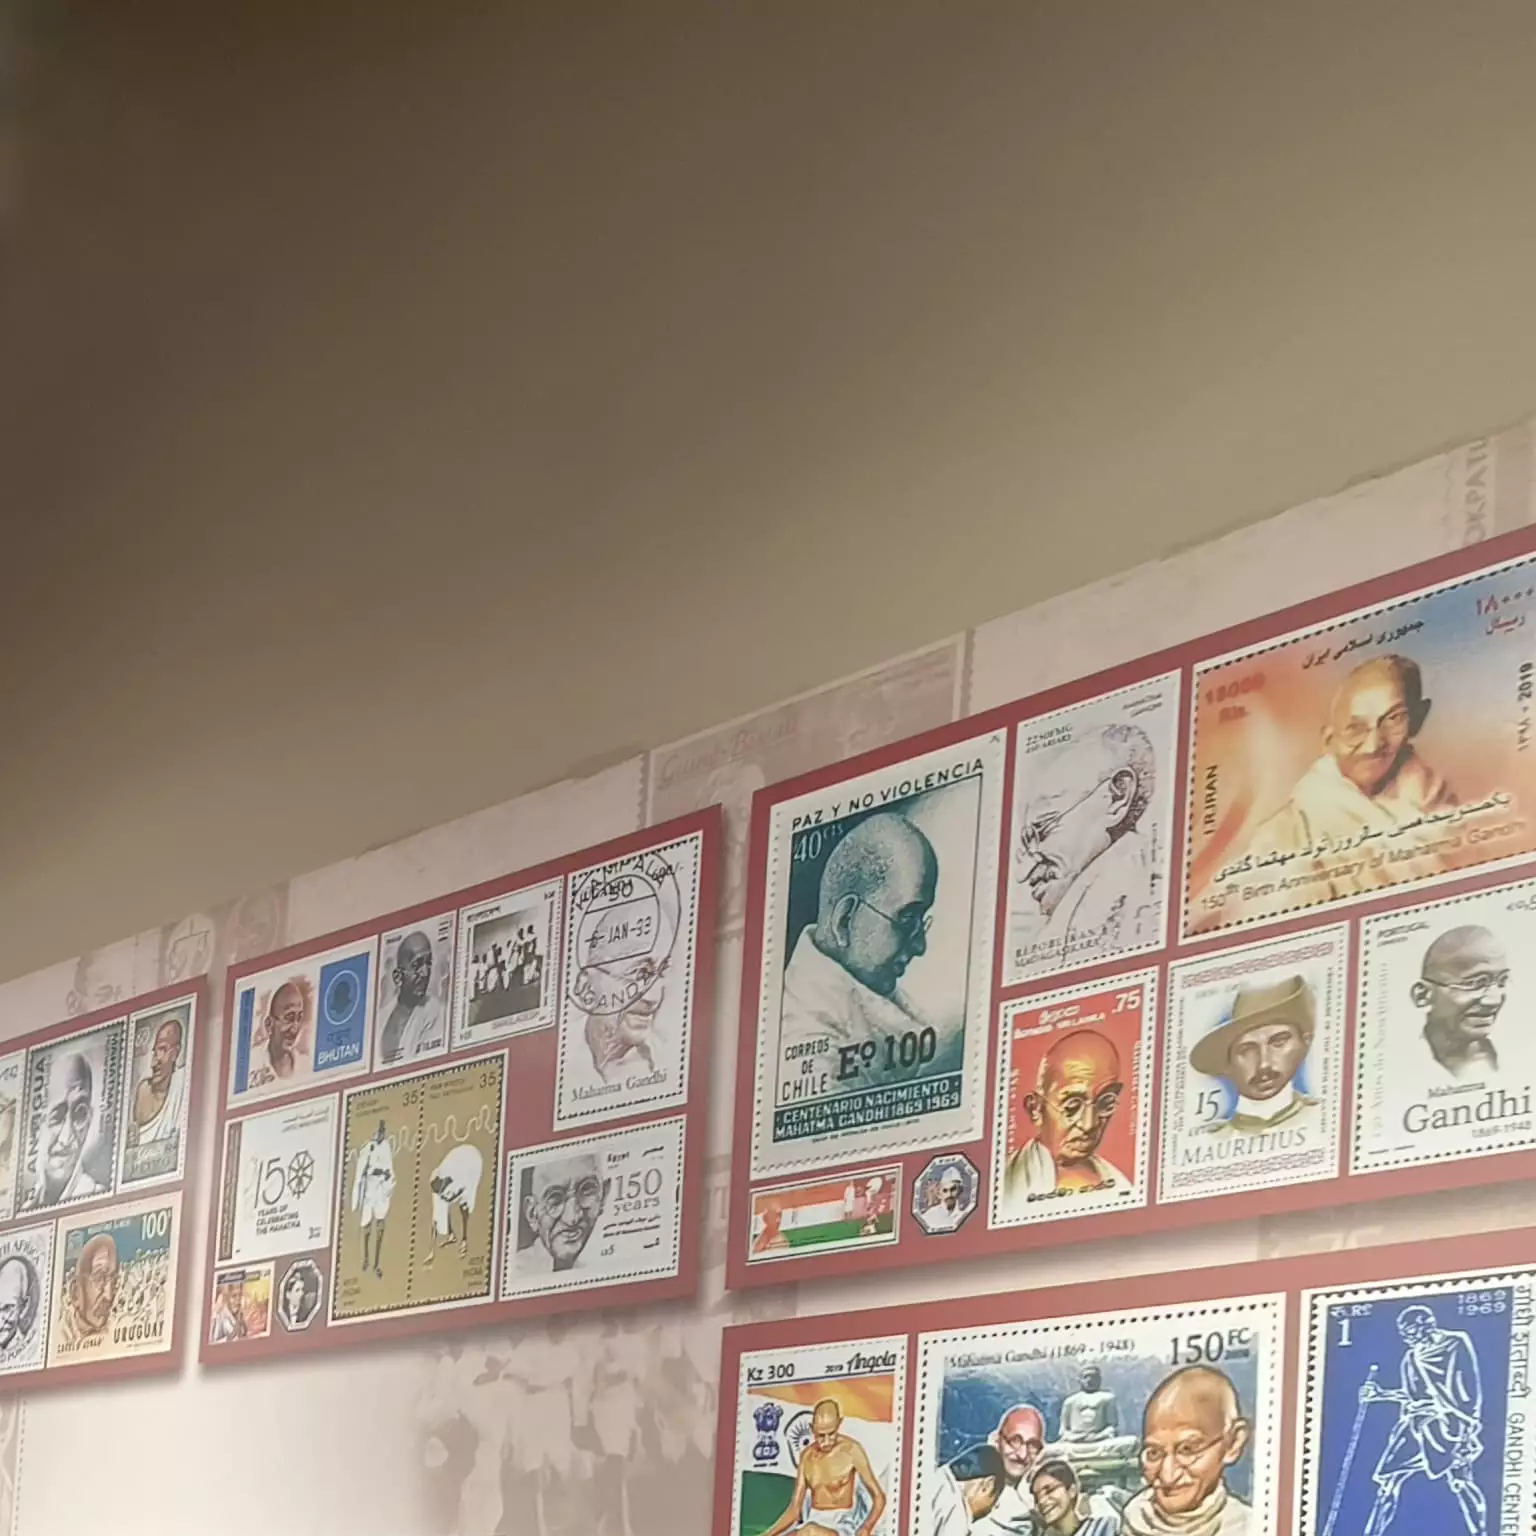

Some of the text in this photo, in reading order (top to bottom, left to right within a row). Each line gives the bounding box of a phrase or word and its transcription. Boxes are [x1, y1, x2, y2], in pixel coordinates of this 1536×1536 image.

[792, 757, 985, 831] PAZ Y NO VIOLENCIA
[318, 1039, 361, 1066] BHUTAN
[801, 1058, 815, 1076] DE
[883, 1026, 937, 1073] 100
[782, 1072, 829, 1102] CHILE
[783, 1079, 950, 1124] CENTENARIO NACIMIENTO
[775, 1117, 835, 1139] MAHATMA
[838, 1106, 891, 1128] GANDHI
[1402, 1085, 1533, 1134] Gandhi
[1181, 1126, 1308, 1167] MAURITIUS
[614, 1167, 663, 1202] 150
[114, 1320, 165, 1344] URUGUAY
[1169, 1331, 1224, 1366] 150
[1337, 1318, 1353, 1347] 1
[767, 1362, 795, 1380] 300
[1503, 1411, 1526, 1480] GANDHI
